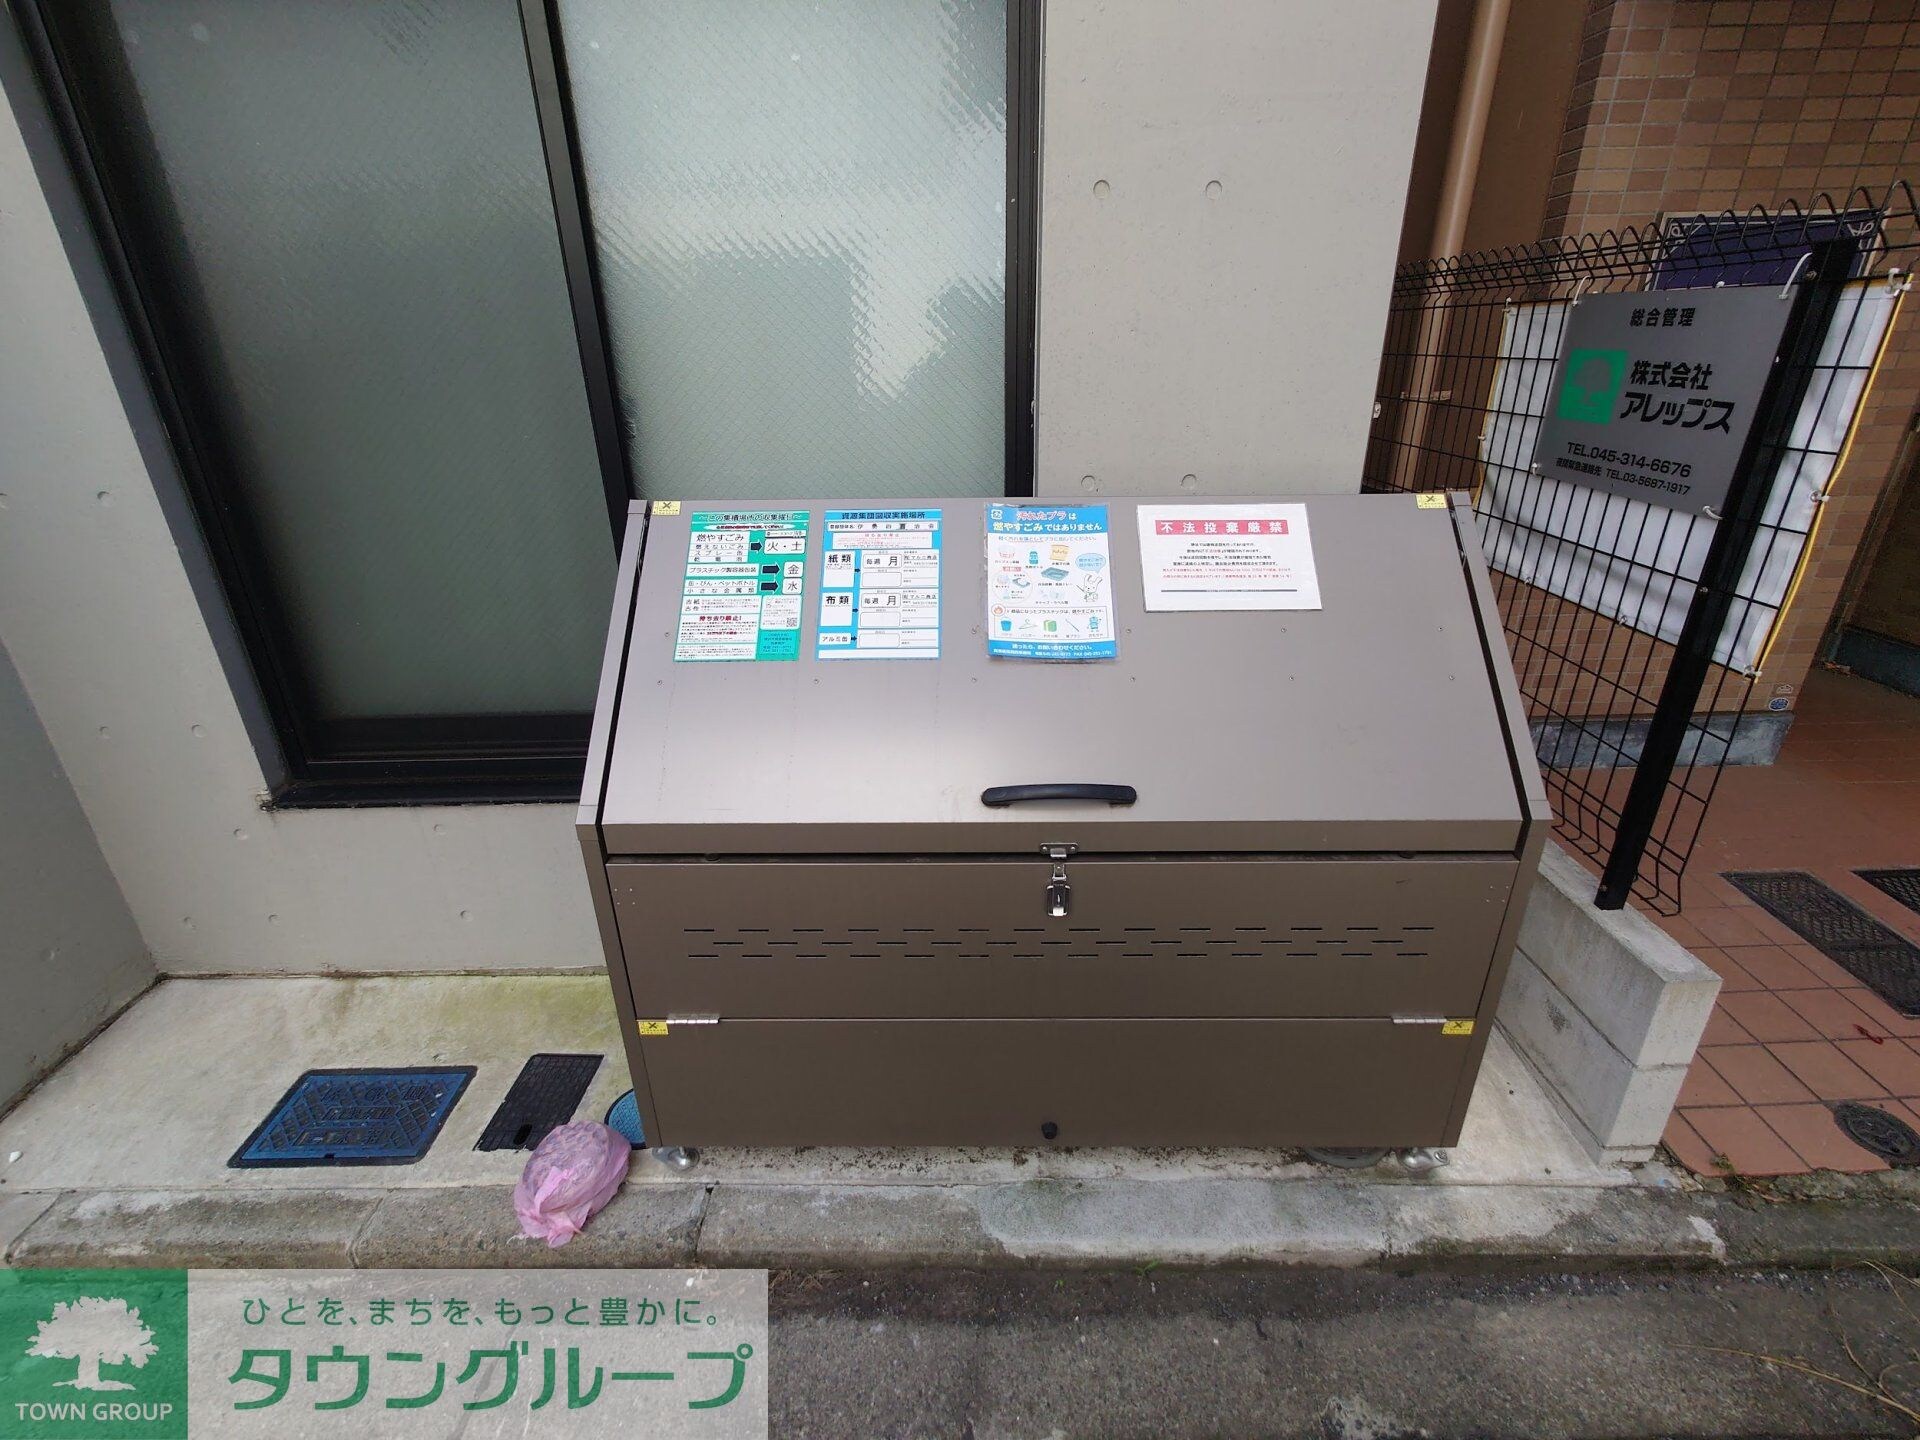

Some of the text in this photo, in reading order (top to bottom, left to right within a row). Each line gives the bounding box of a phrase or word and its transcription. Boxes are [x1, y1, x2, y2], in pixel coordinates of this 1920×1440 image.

[1629, 307, 1696, 327] 総合管理
[1630, 360, 1713, 390] 株式会社
[1619, 391, 1736, 434] アレップス
[1567, 441, 1692, 478] TEL.045-314-6676
[1606, 468, 1691, 496] TEL.03-5687-1917
[992, 521, 1103, 532] 燃やすごみではありません
[1160, 522, 1283, 533] 不法投棄厳禁
[696, 533, 744, 542] 燃やすごみ
[828, 553, 852, 563] 紙類
[866, 557, 881, 565] 毎週
[888, 555, 898, 566] 月
[787, 564, 799, 575] 金
[787, 581, 798, 591] 水
[825, 595, 850, 605] 布類
[886, 595, 897, 606] 月
